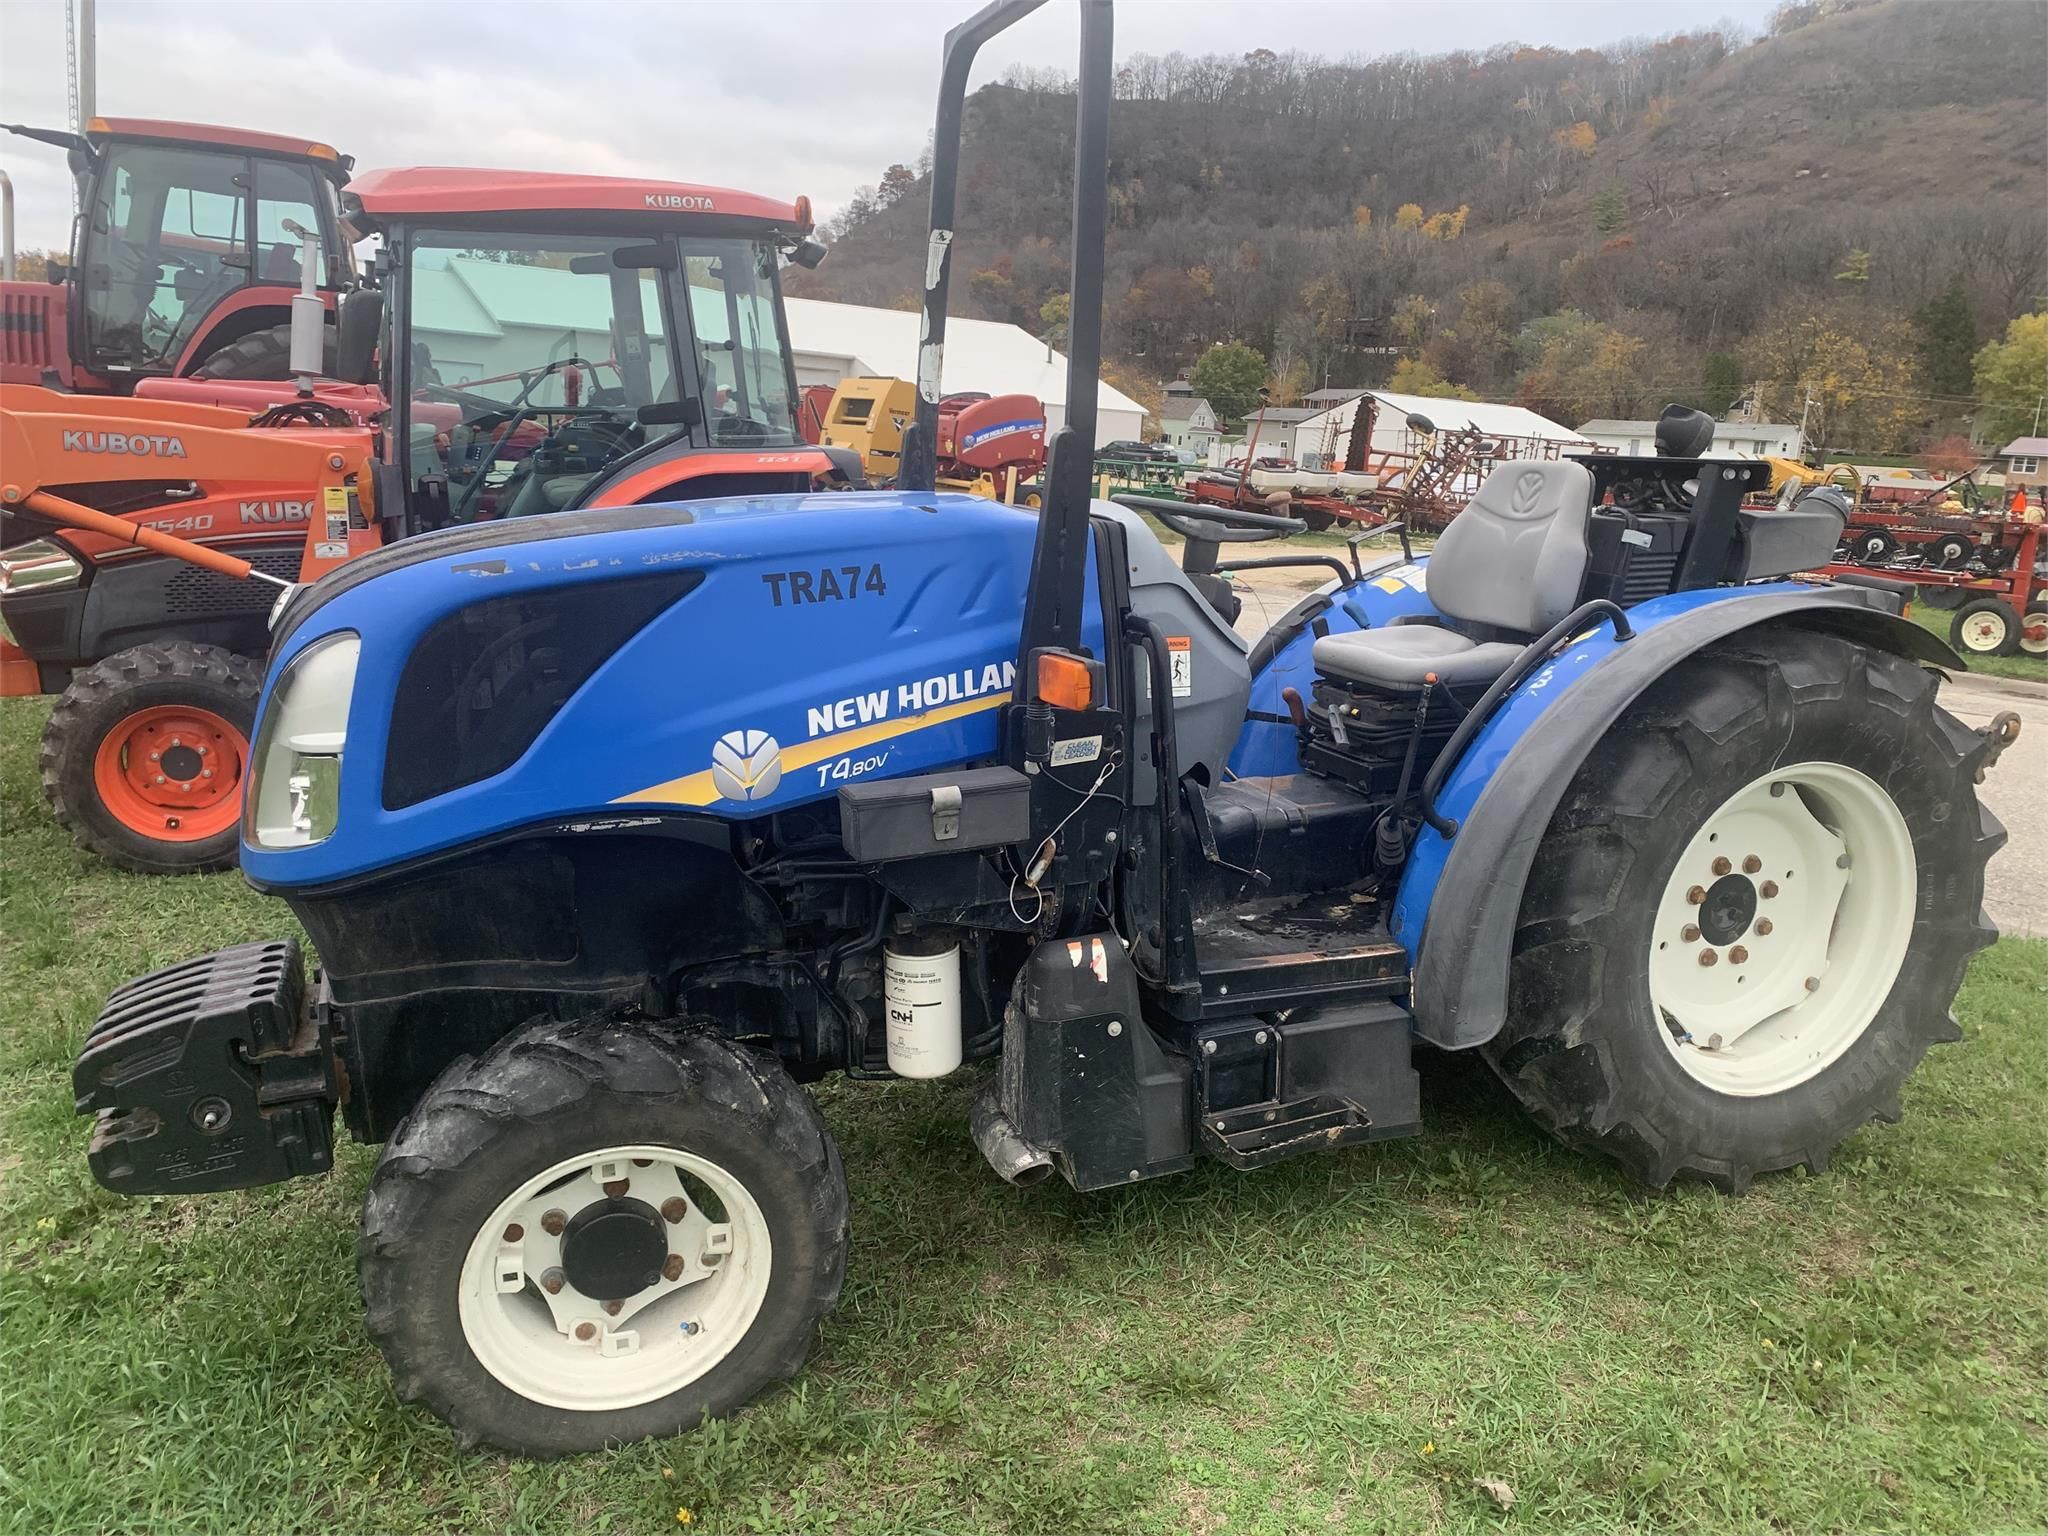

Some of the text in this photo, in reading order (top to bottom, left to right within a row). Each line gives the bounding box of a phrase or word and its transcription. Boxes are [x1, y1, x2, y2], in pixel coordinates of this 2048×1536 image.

[644, 194, 715, 210] KUBOTA
[63, 430, 188, 458] KUBOTA
[976, 433, 990, 444] NEW
[990, 425, 1016, 438] HOLLAND
[762, 563, 887, 607] TRA74
[807, 658, 1018, 736] NEW HOLLAN
[1065, 745, 1096, 755] ENERGY
[1067, 740, 1094, 749] CLEAN
[1064, 750, 1096, 760] LEADER
[817, 752, 889, 787] T4.80V
